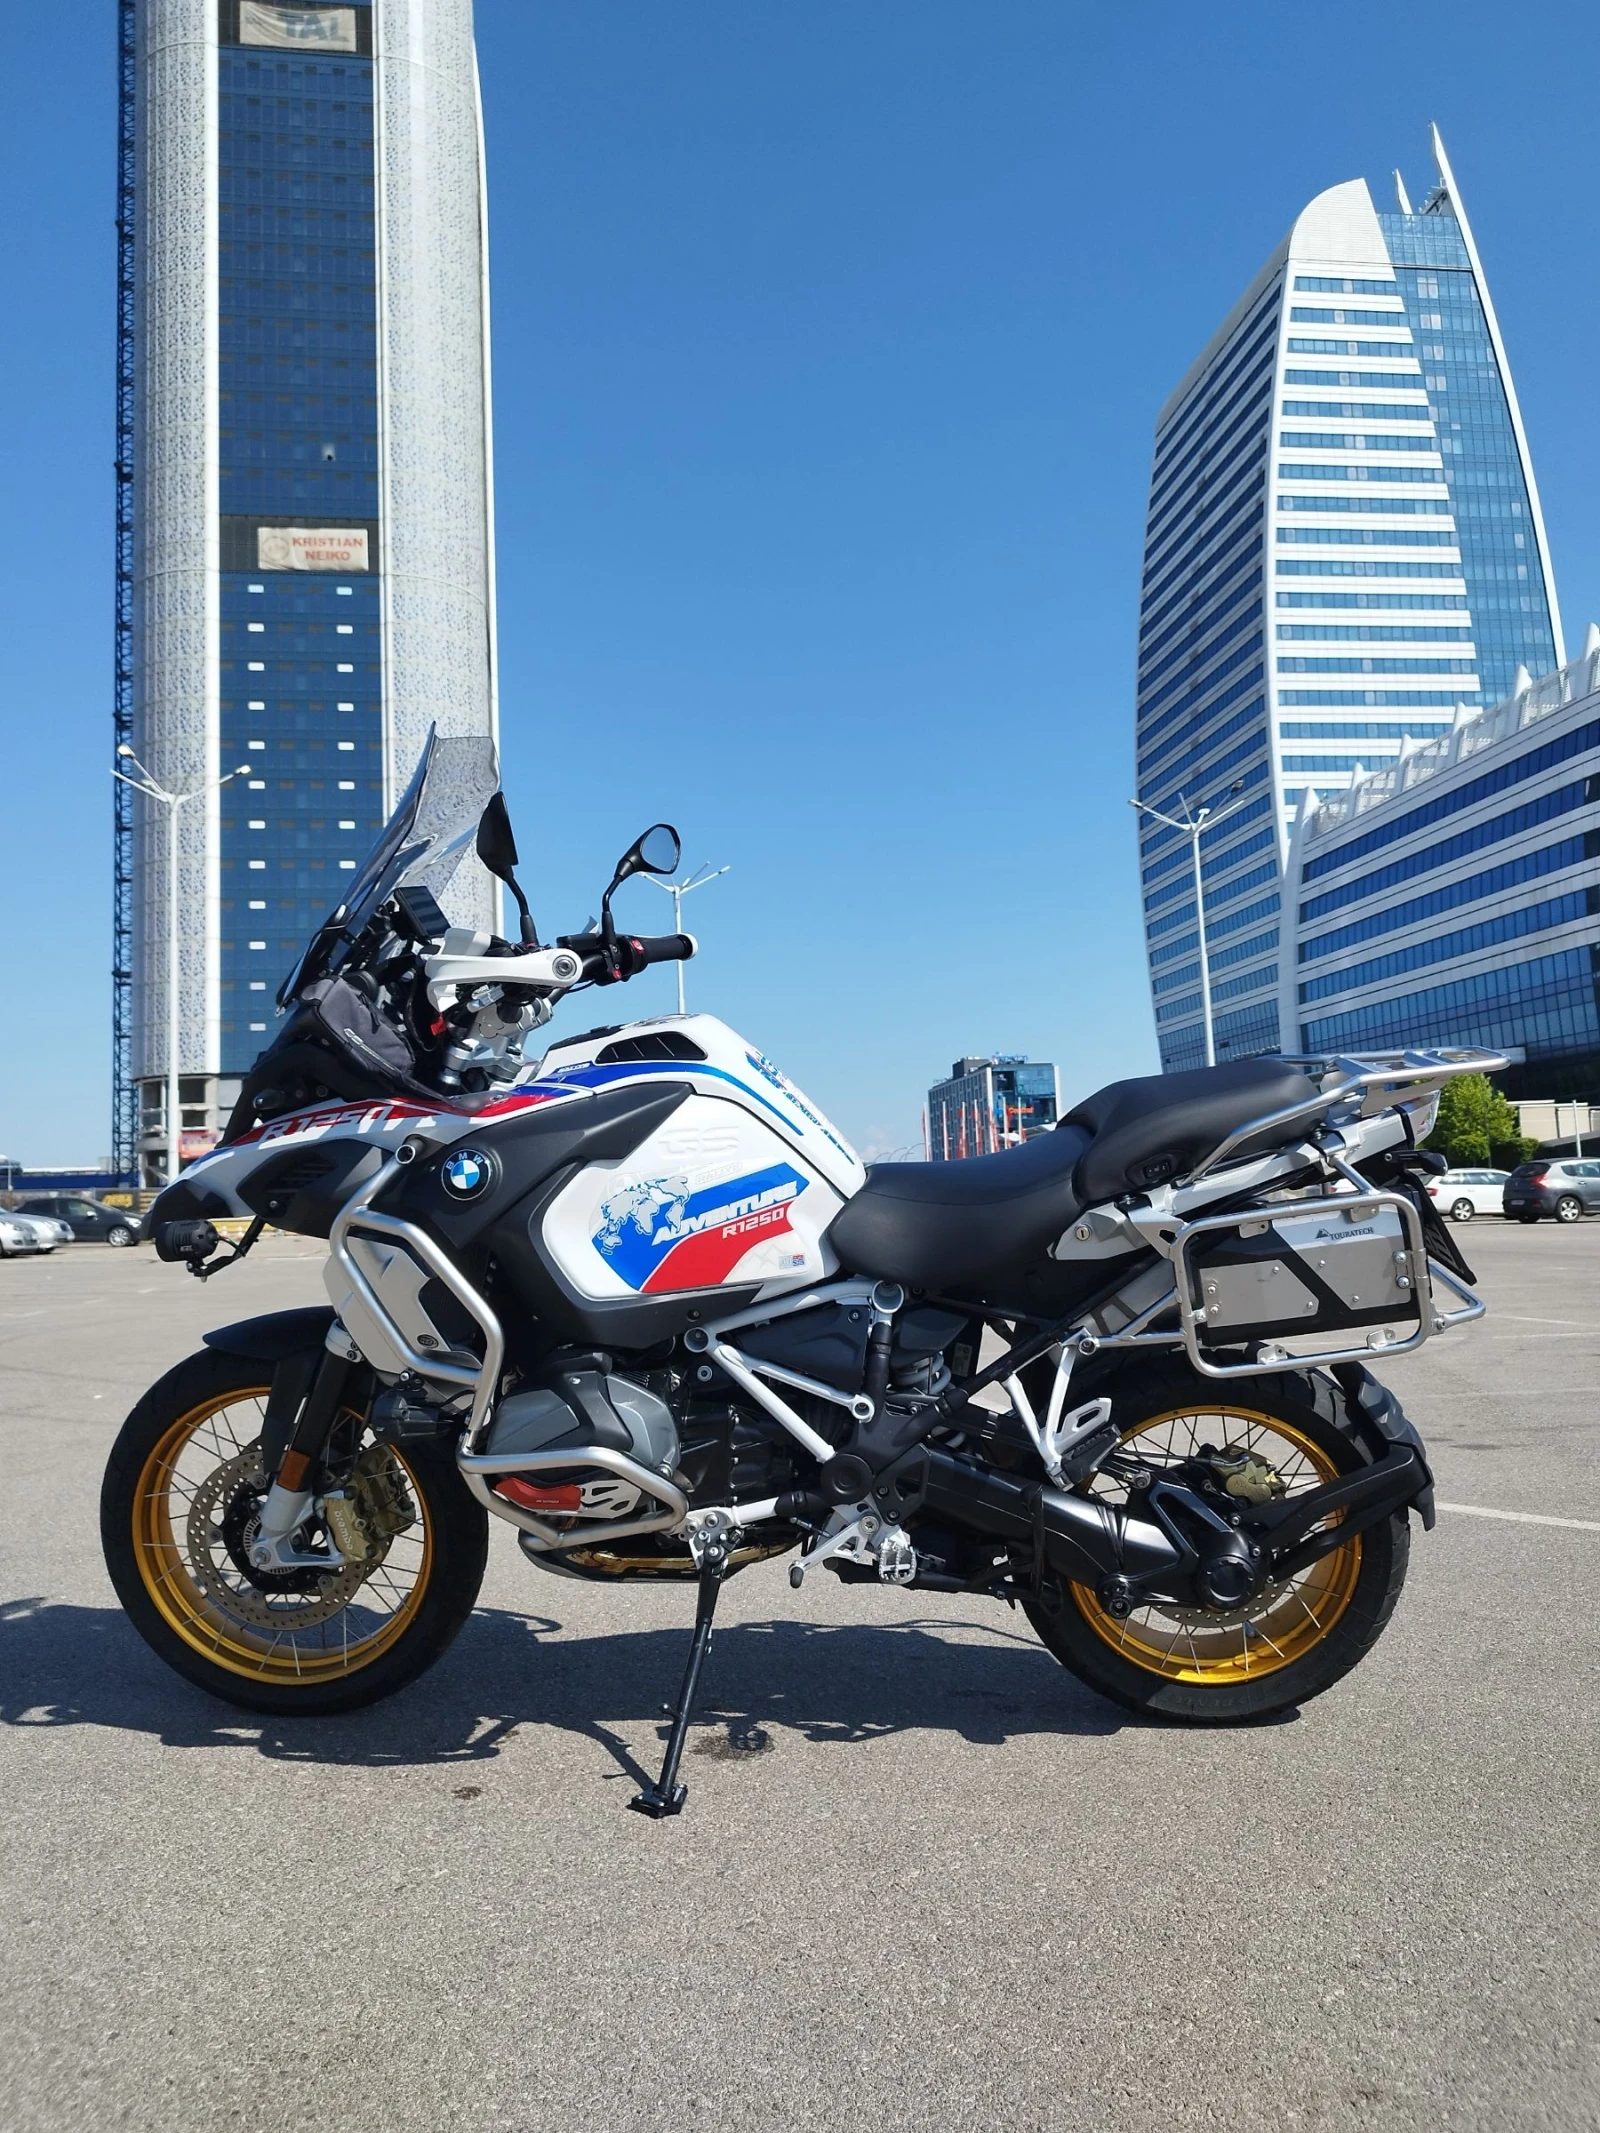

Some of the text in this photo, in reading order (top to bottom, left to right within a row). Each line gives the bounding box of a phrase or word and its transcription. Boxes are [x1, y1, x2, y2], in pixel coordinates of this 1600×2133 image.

[292, 537, 363, 547] KRISTIAN
[305, 551, 350, 561] NEIKO
[445, 1151, 484, 1170] BMW
[722, 1207, 785, 1239] R1250
[1330, 1226, 1374, 1240] TOURATECH
[334, 1510, 354, 1550] brembo
